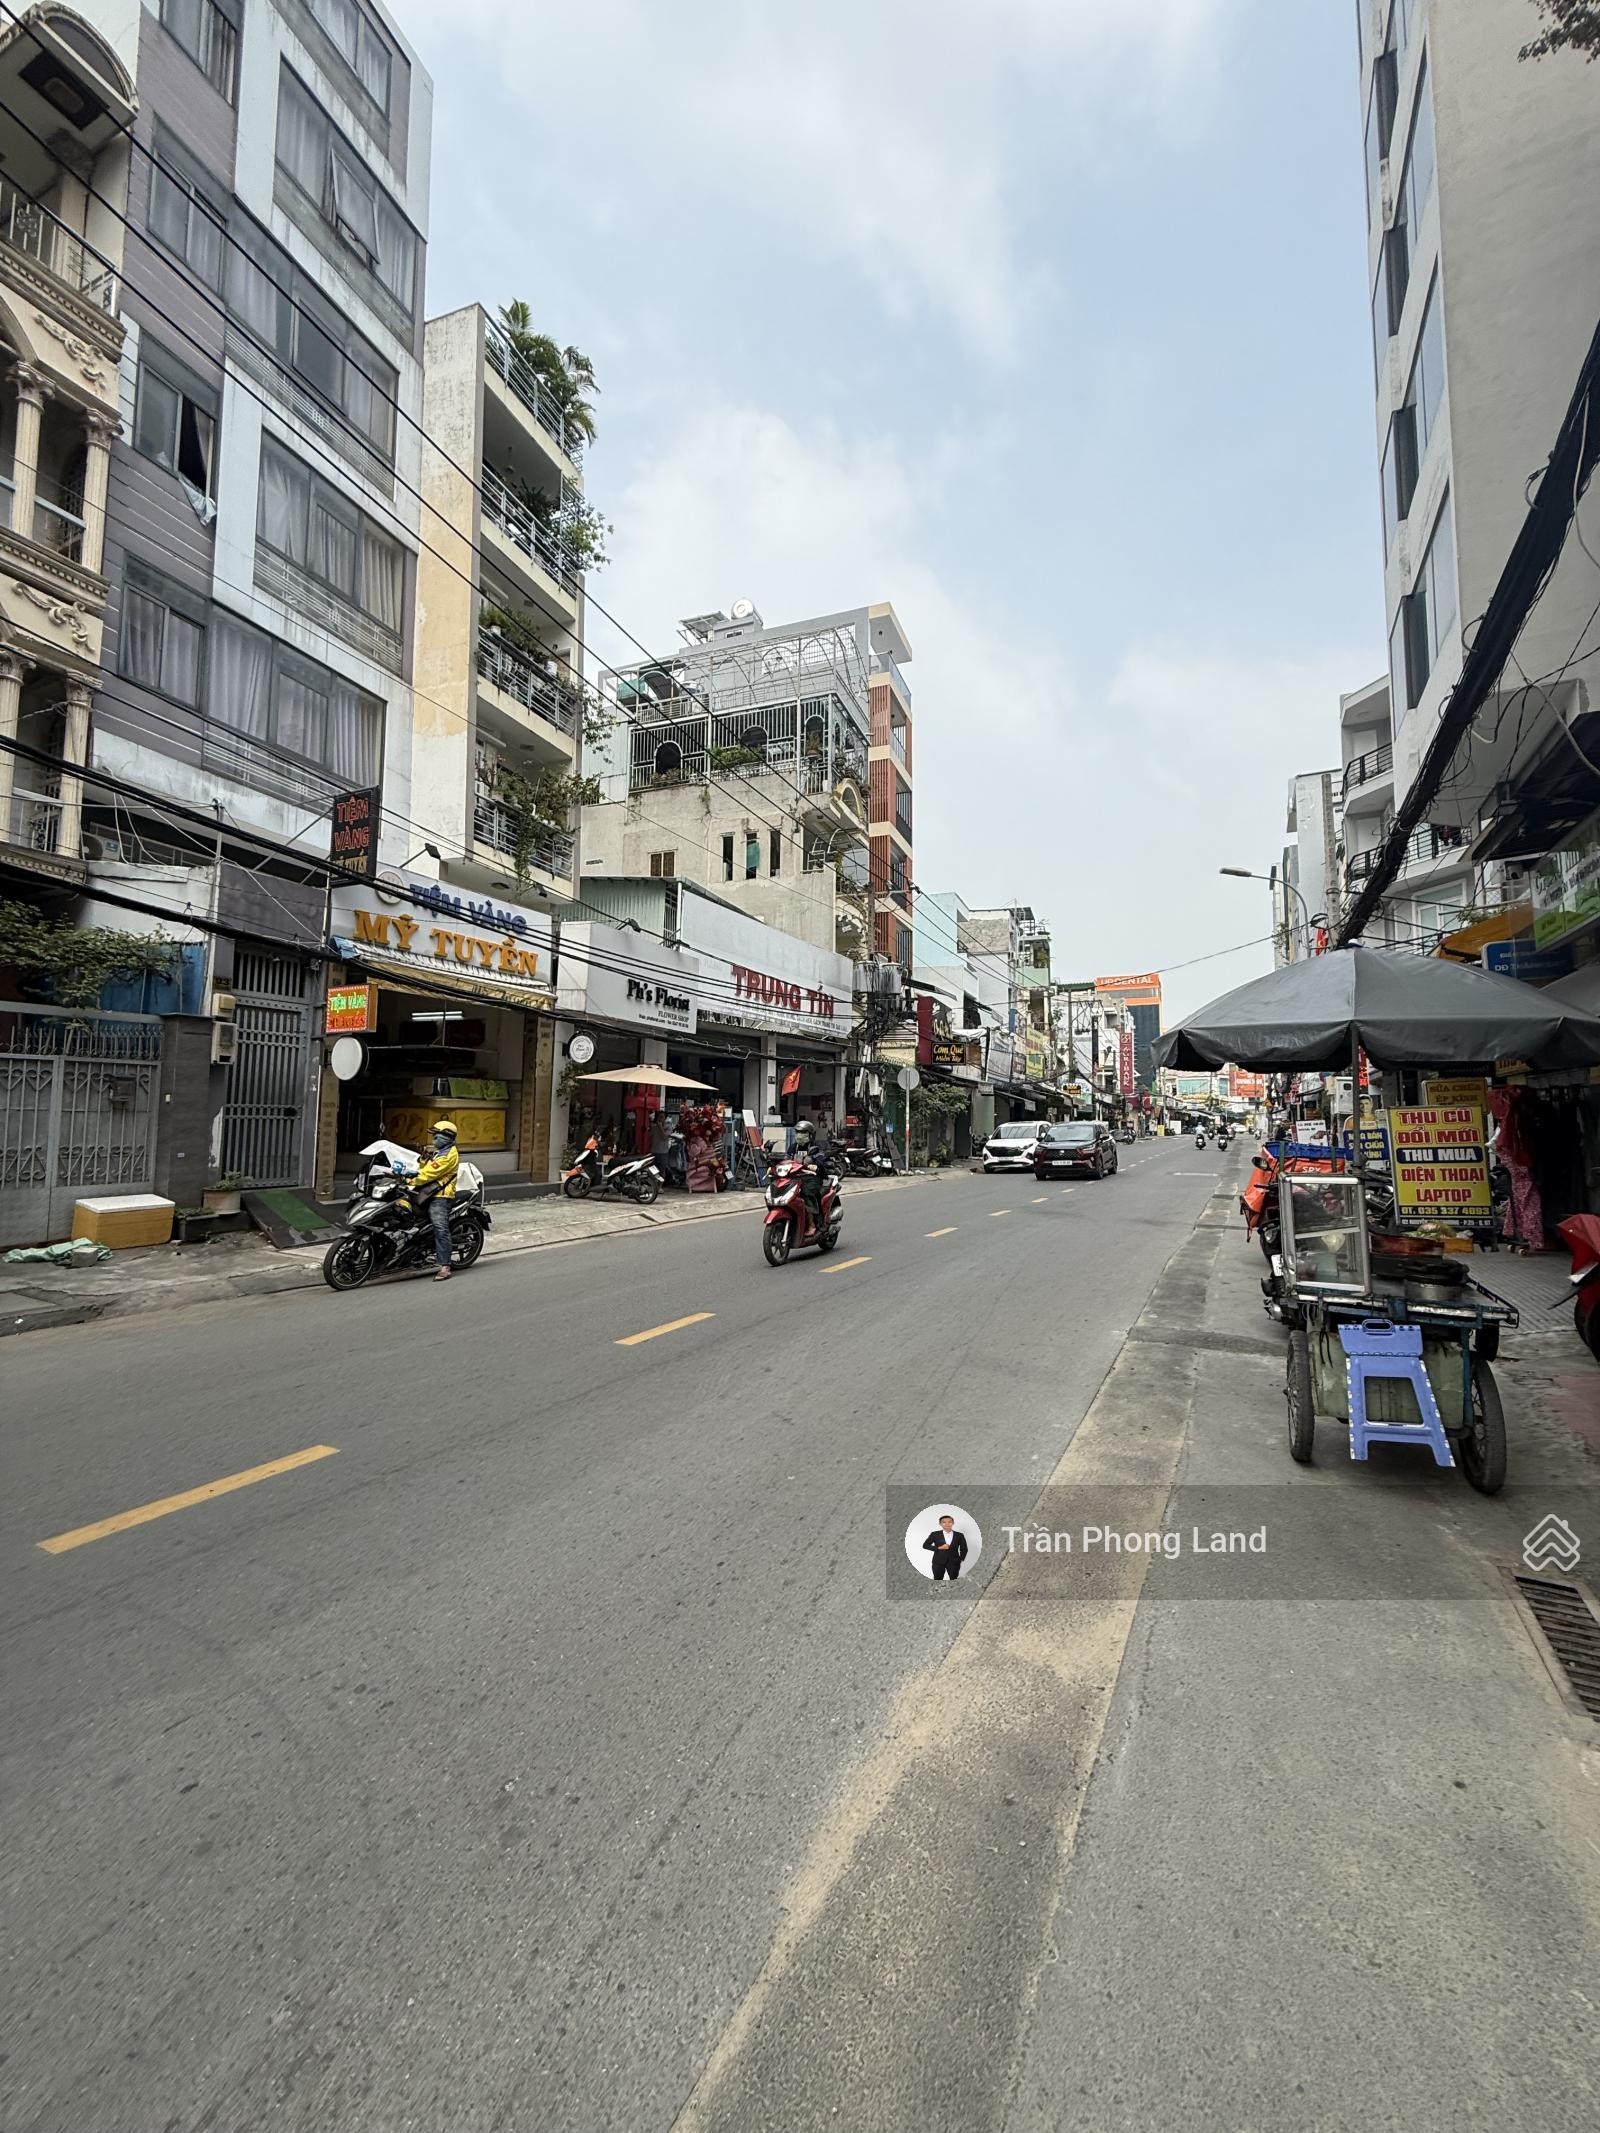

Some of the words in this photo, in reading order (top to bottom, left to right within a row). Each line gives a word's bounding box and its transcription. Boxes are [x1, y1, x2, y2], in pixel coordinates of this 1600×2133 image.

[336, 796, 369, 825] TIỆM
[334, 826, 369, 851] VÀNG
[409, 884, 461, 918] TIỆM
[469, 900, 528, 934] VÀNG
[353, 909, 420, 950] MỸ
[627, 978, 654, 1002] Ph's
[731, 964, 801, 1009] TRUNG
[1398, 1111, 1438, 1125] THU
[1442, 1107, 1472, 1124] CŨ
[1397, 1125, 1431, 1144] ĐỔI
[1436, 1126, 1479, 1143] MỚI
[1402, 1149, 1434, 1161] THU
[1437, 1148, 1478, 1161] MUA
[1401, 1166, 1436, 1185] ĐIỆN
[1440, 1167, 1485, 1185] THOẠI
[1416, 1188, 1472, 1203] LAPTOP
[1417, 1206, 1439, 1215] 035
[1440, 1206, 1460, 1215] 337
